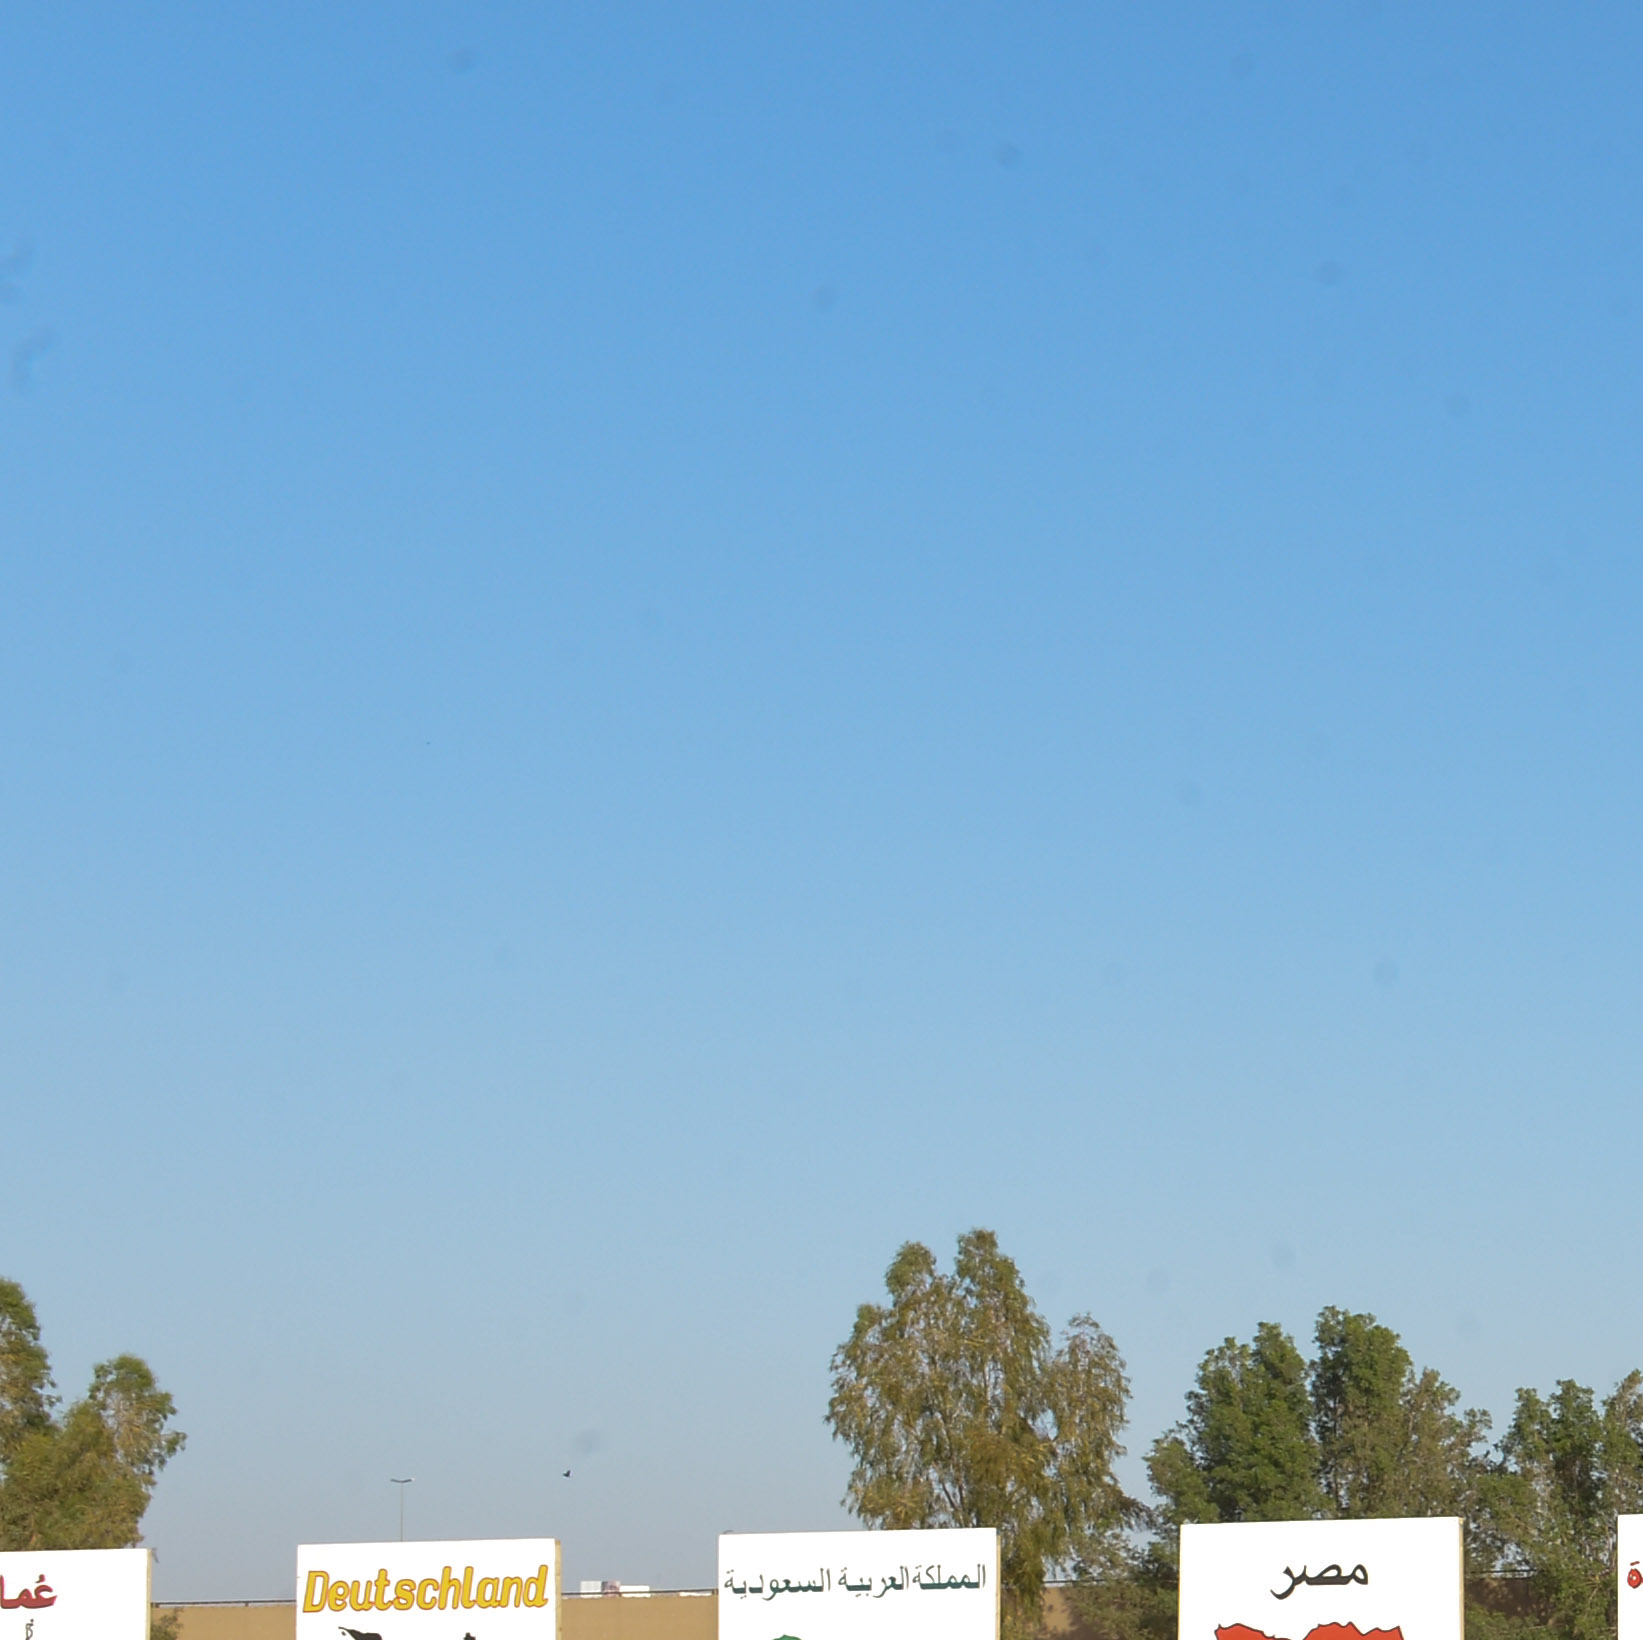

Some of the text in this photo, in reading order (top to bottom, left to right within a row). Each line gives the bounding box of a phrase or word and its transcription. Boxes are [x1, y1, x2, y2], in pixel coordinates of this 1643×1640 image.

[302, 1564, 549, 1613] Deutschland
[724, 1563, 987, 1601] المملكة العربية السعودية
[1270, 1564, 1369, 1600] مصر
